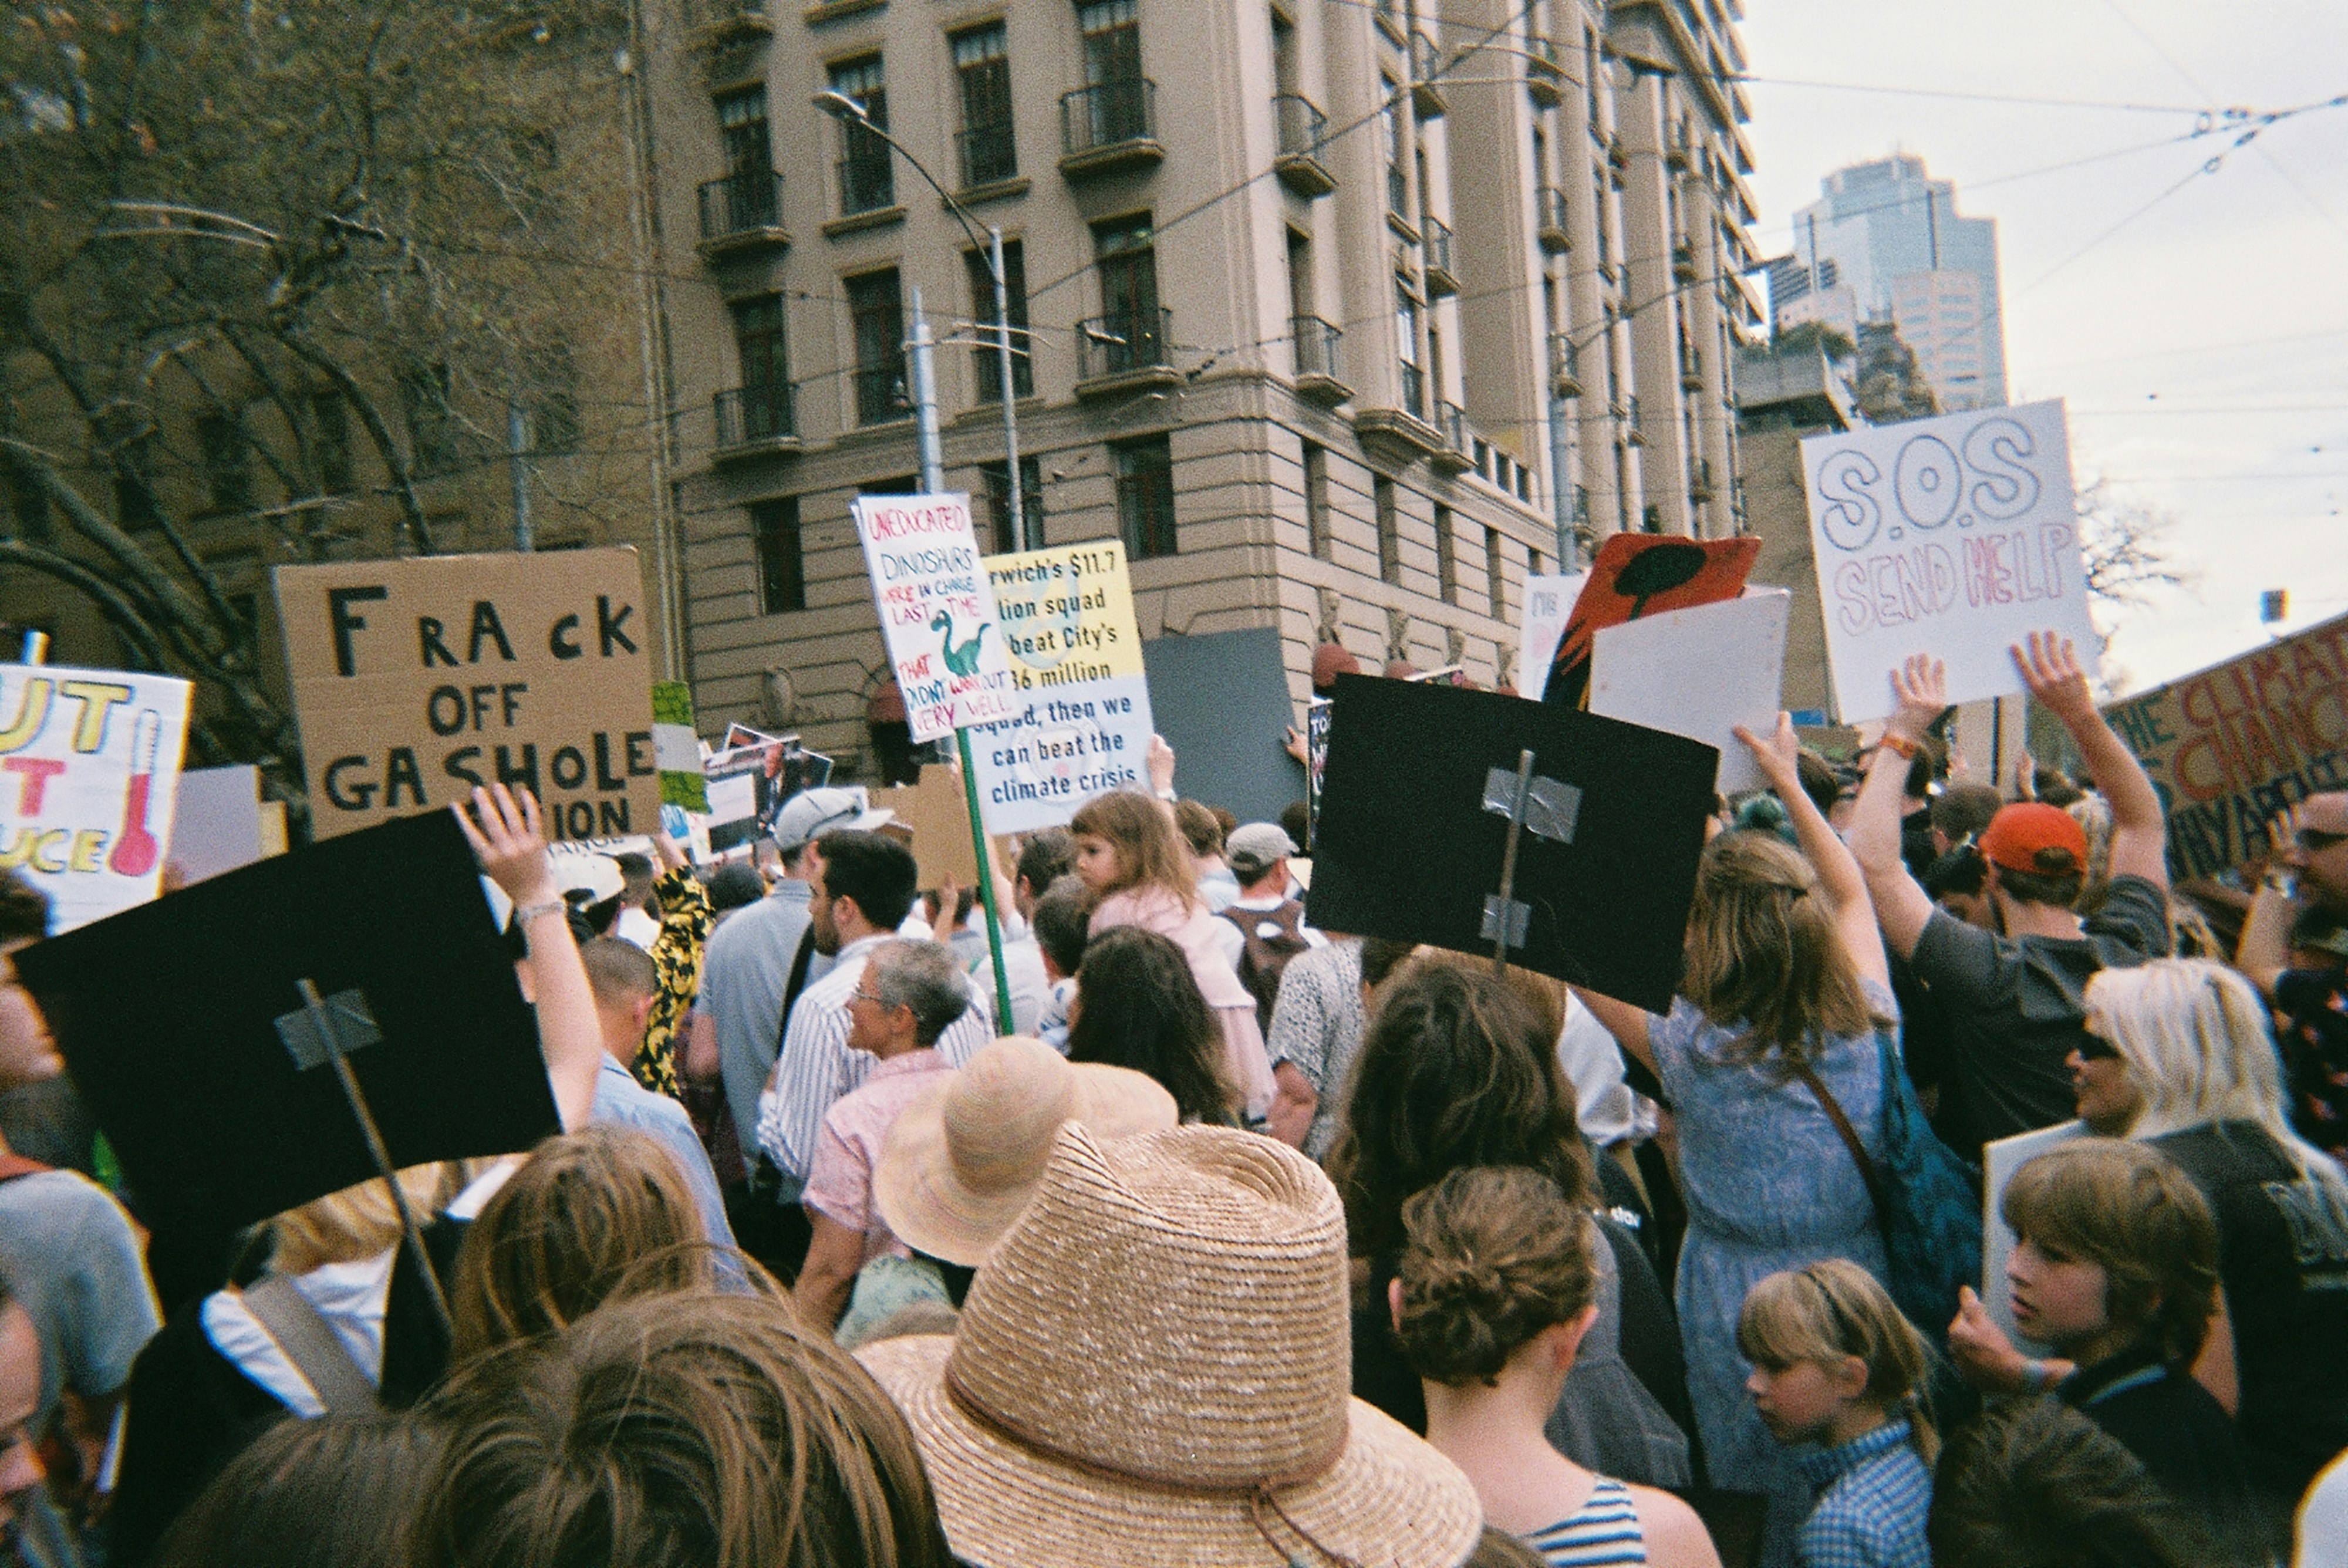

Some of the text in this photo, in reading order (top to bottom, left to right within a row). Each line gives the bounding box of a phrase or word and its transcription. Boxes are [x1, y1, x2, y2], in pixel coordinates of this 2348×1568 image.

[1818, 417, 2040, 551] S.O.S
[1070, 551, 1116, 578] $11.7
[1834, 522, 2072, 636] SEND HELP
[918, 582, 932, 599] IN
[1045, 587, 1105, 619] squad
[892, 601, 930, 626] LAST
[1008, 622, 1118, 655] beat City's
[1041, 661, 1112, 687] million
[428, 683, 527, 736] OFF
[912, 694, 1012, 731] VERY WELL
[1048, 700, 1095, 722] then
[1104, 696, 1132, 715] we
[993, 731, 1124, 766] can beat the
[992, 765, 1136, 804] climate crisis
